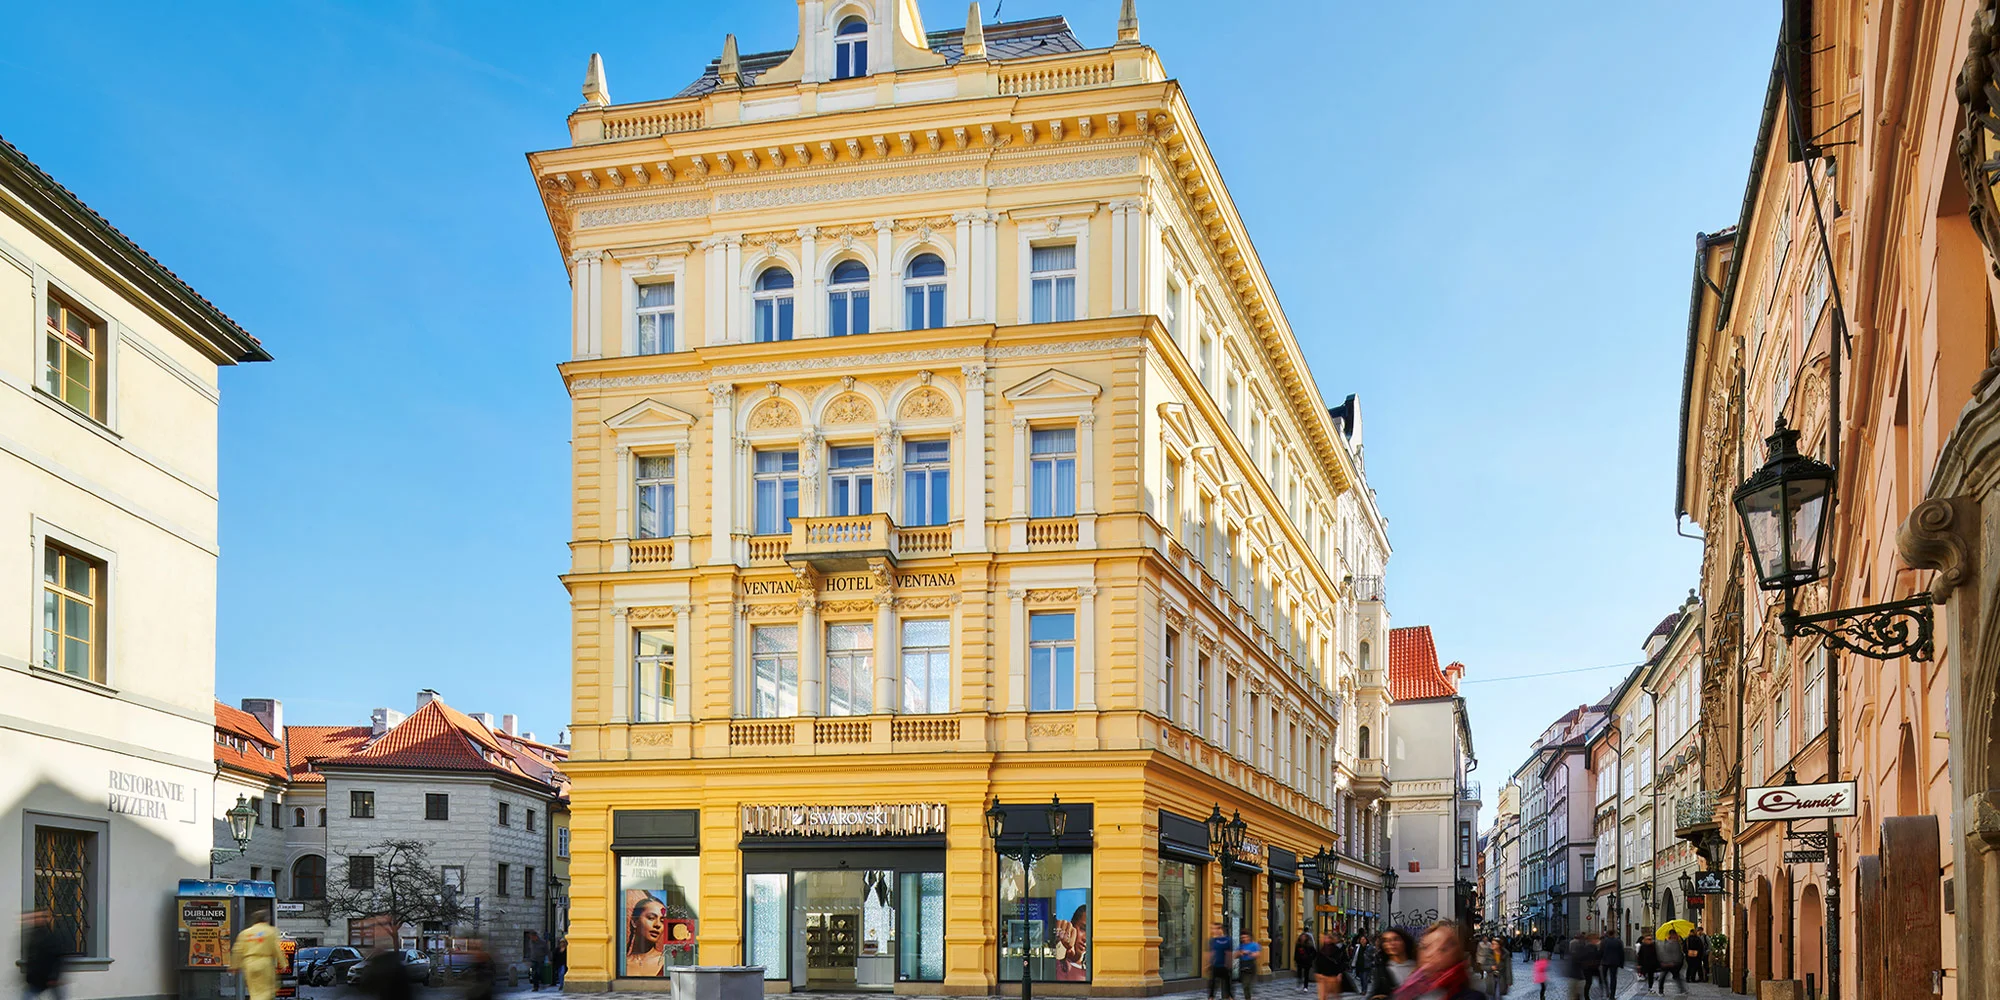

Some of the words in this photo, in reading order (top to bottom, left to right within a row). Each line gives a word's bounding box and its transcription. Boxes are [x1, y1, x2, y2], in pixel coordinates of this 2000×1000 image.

[826, 577, 873, 592] HOTEL
[896, 573, 956, 588] VENTANA
[108, 769, 184, 802] RISTORANTE
[107, 792, 168, 821] PIZZERIA
[1748, 790, 1846, 813] Granát
[809, 811, 888, 825] SWAROVSKI
[184, 909, 225, 918] DUBLINER
